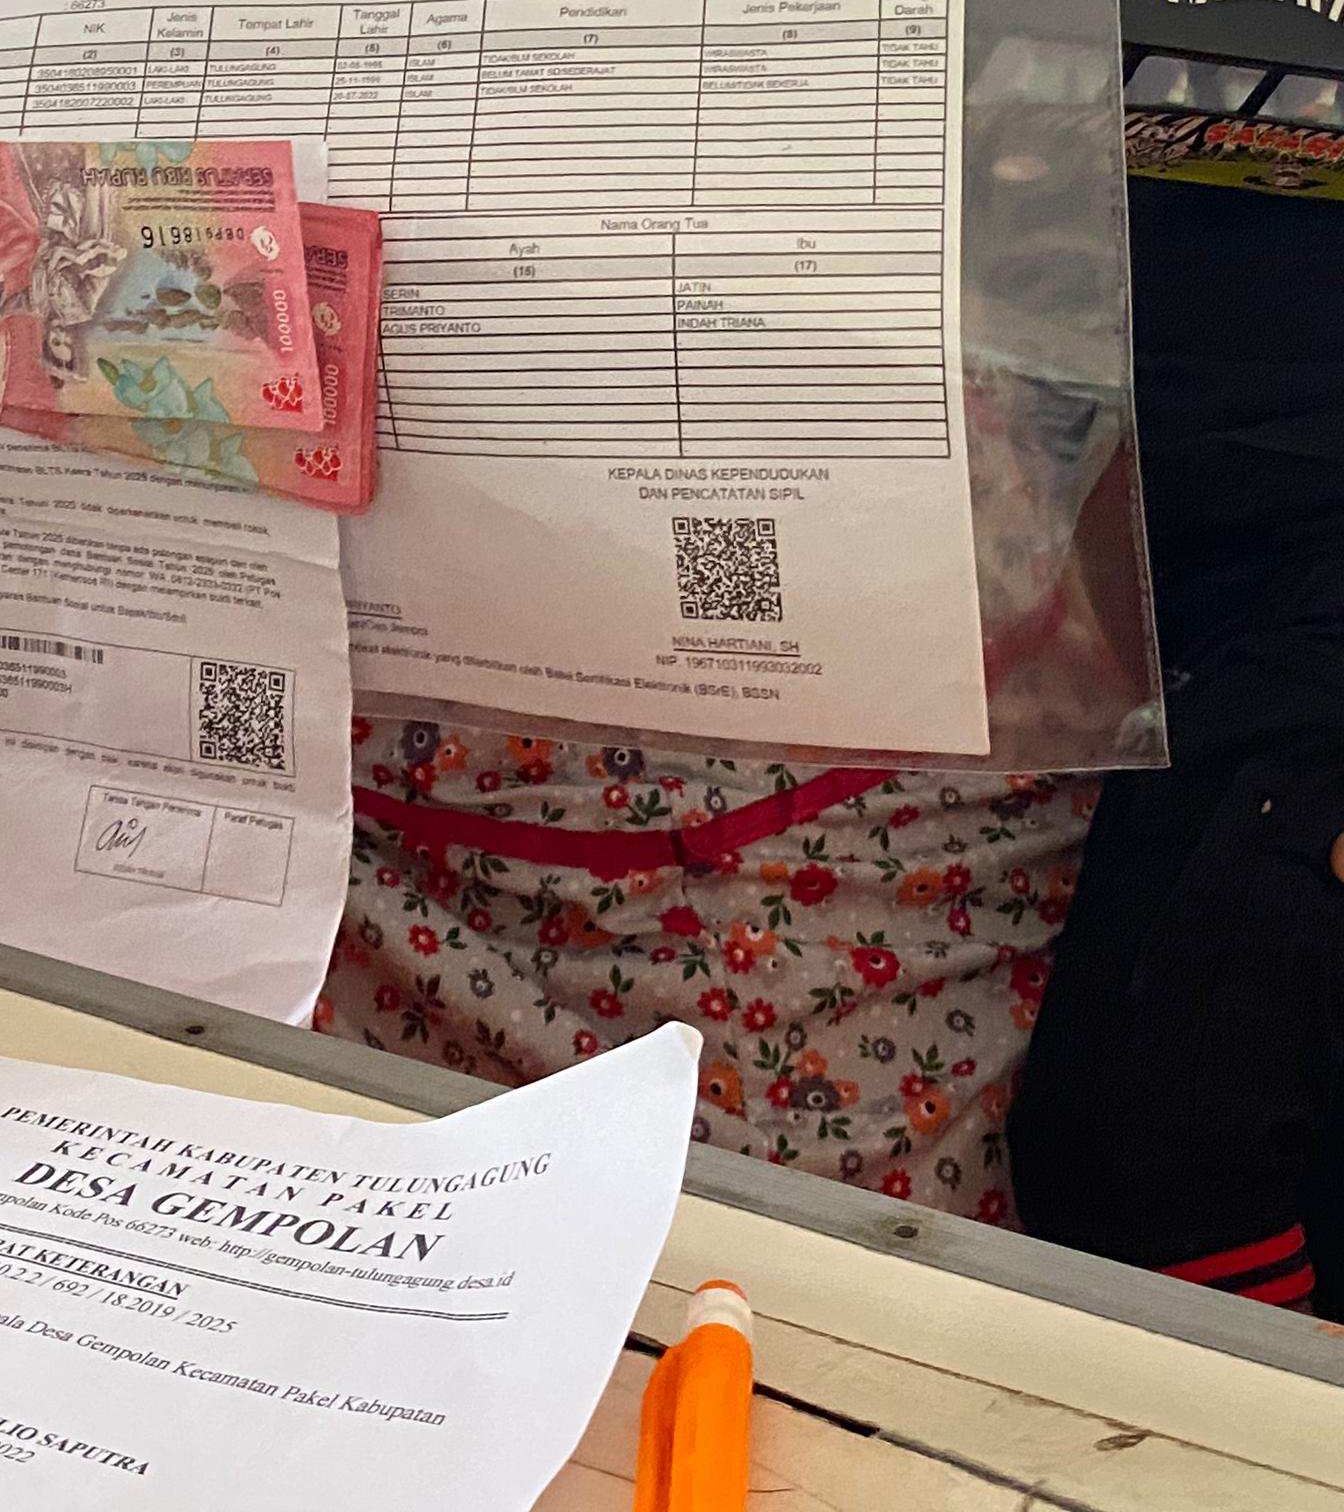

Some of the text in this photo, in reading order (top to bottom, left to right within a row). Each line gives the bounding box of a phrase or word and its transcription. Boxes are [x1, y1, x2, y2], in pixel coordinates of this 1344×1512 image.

[83, 22, 106, 34] NIK
[81, 166, 274, 187] SERATUS RIBU RUPIAH
[600, 216, 709, 233] Nama Orang Tua
[509, 242, 541, 257] Ayah
[794, 259, 818, 273] (17)
[272, 289, 294, 352] 100000
[382, 321, 481, 334] AGUS PRIYANTO
[718, 316, 766, 329] TRIANA
[608, 467, 830, 481] KEPALA DINAS KEPENDUDUKAN
[639, 487, 805, 501] DAN PENCATATAN SIPIL
[1, 1106, 552, 1195] PEMERINTAH KABUPATEN TULUNGAGUNG
[13, 1161, 447, 1263] DESA GEMPOLAN
[52, 1202, 94, 1223] Kode
[96, 1212, 124, 1229] Pos
[125, 1219, 177, 1240] 66273
[32, 1249, 189, 1298] KETERANGAN
[185, 1312, 239, 1334] 2025
[27, 1320, 74, 1343] Desa
[75, 1332, 170, 1370] Gempolan
[173, 1360, 280, 1396] Kecamatan
[281, 1385, 339, 1411] Pakel
[35, 1432, 153, 1477] SAPUTRA
